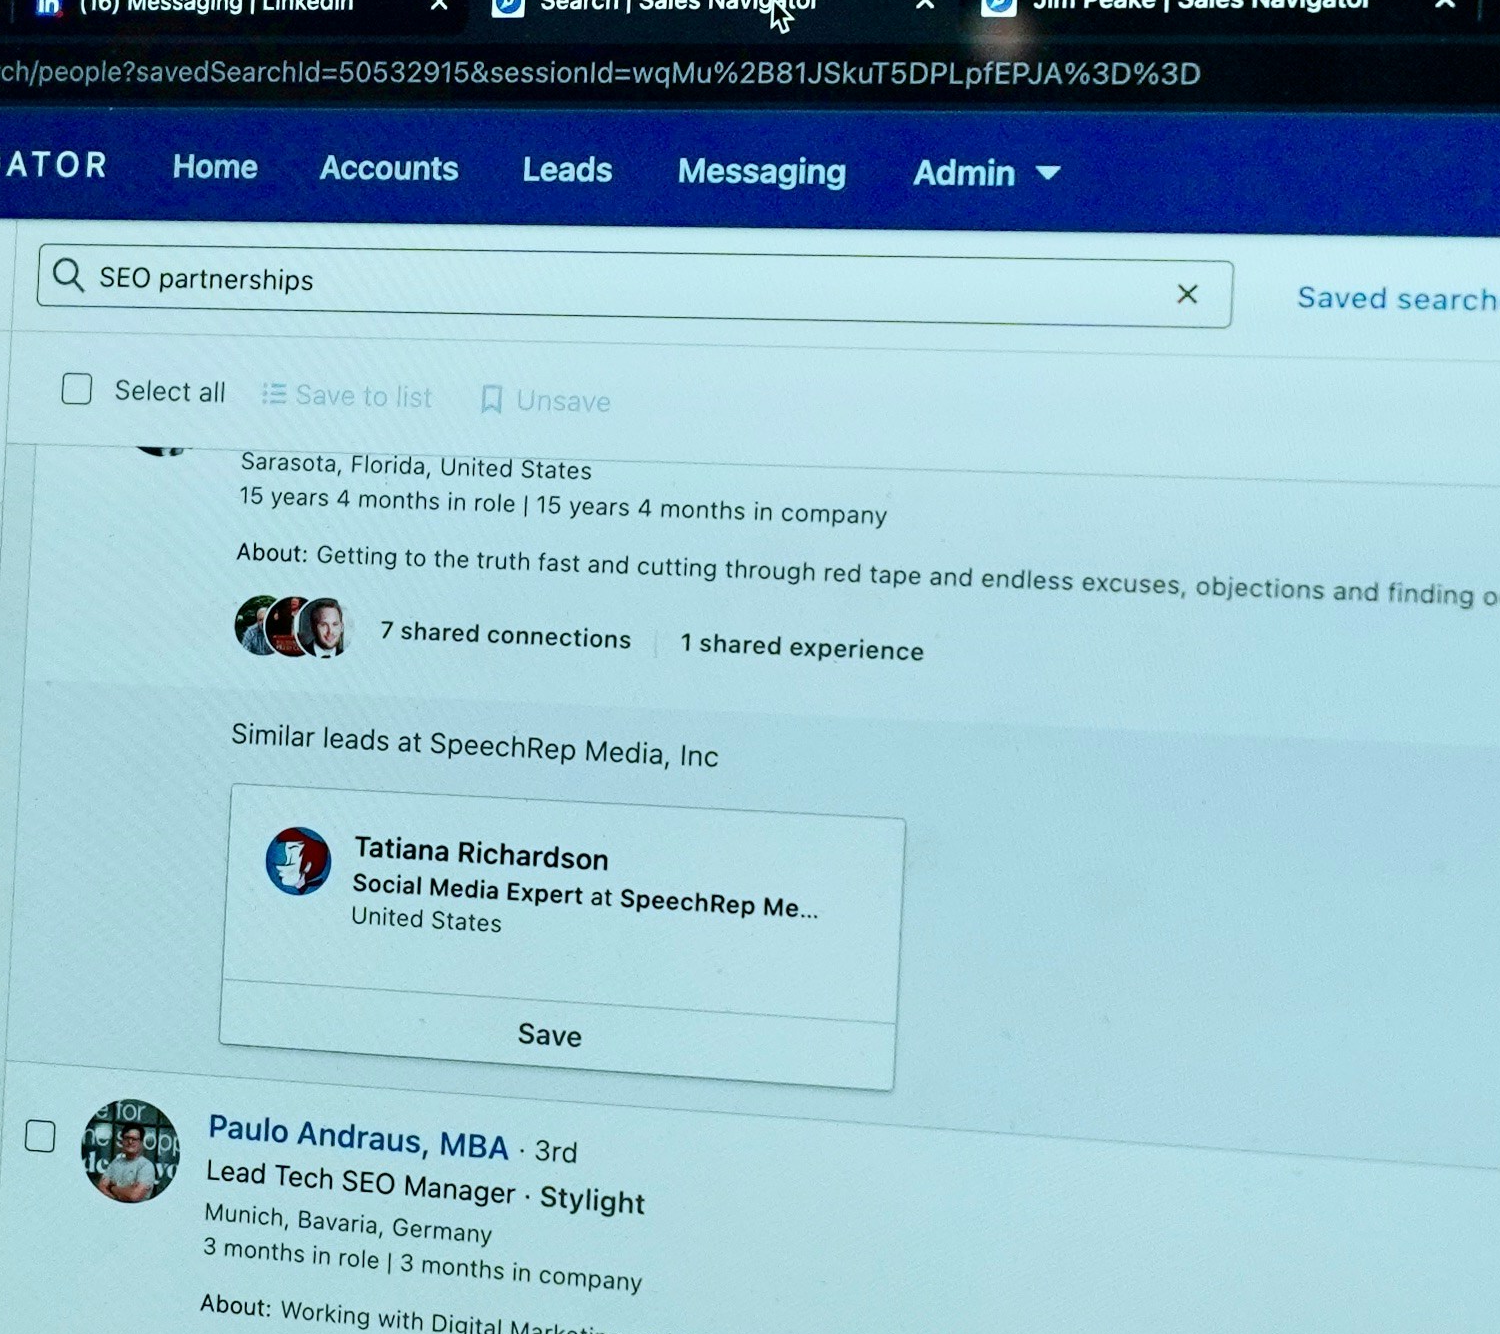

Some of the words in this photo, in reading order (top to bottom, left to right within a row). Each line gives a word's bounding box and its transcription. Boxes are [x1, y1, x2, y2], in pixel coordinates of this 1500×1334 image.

[173, 153, 259, 180] Home
[318, 154, 459, 182] Accounts
[523, 155, 613, 183] Leads
[678, 156, 847, 191] Messaging
[912, 157, 1016, 187] Admin
[99, 266, 151, 289] SEO
[159, 268, 314, 296] partnerships
[1298, 285, 1387, 310] Saved
[115, 379, 191, 403] Select
[199, 380, 225, 404] all
[241, 451, 342, 477] Sarasota,
[351, 454, 431, 480] Florida,
[441, 457, 513, 478] United
[521, 459, 592, 481] States
[380, 620, 394, 640] 7
[400, 620, 480, 643] shared
[487, 627, 631, 650] connections
[681, 632, 691, 652] 1
[699, 633, 782, 656] shared
[789, 638, 924, 662] experience
[231, 722, 316, 748] Similar
[323, 726, 389, 752] leads
[397, 732, 422, 753] at
[430, 731, 576, 766] SpeechRep
[585, 739, 670, 771] Media,
[681, 744, 719, 768] Inc
[354, 835, 449, 863] Tatiana
[458, 840, 609, 872] Richardson
[518, 1022, 582, 1048] Save
[209, 1113, 289, 1144] Paulo
[296, 1120, 429, 1161] Andraus,
[440, 1131, 509, 1161] MBA
[535, 1139, 578, 1164] 3rd
[207, 1158, 266, 1185] Lead
[274, 1164, 333, 1190] Tech
[342, 1169, 396, 1196] SEO
[404, 1174, 517, 1208] Manager
[540, 1185, 646, 1218] Stylight
[205, 1202, 289, 1232] Munich,
[298, 1209, 383, 1240] Bavaria,
[392, 1217, 493, 1249] Germany
